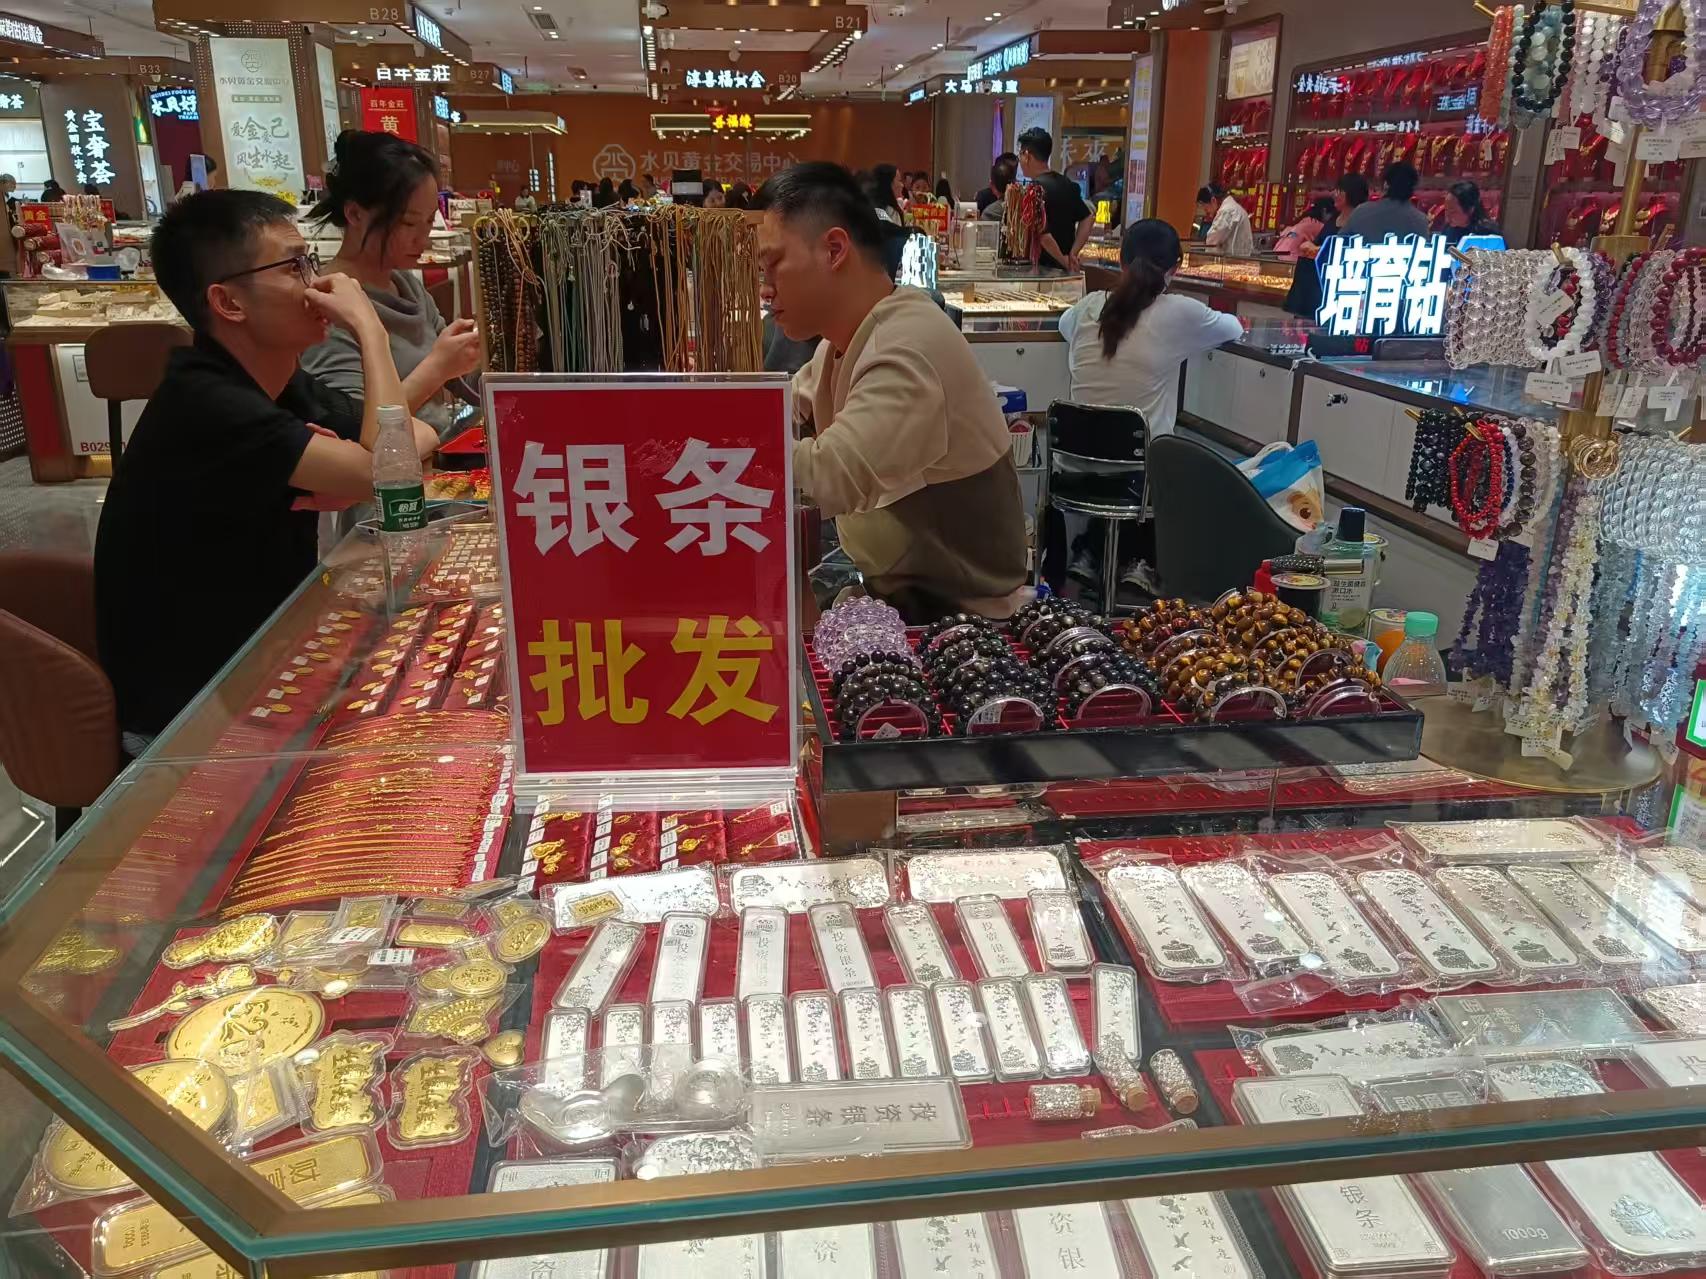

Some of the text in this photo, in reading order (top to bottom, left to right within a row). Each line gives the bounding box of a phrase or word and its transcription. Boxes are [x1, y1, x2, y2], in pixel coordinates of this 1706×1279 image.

[370, 8, 399, 20] B28
[835, 16, 861, 29] B21
[140, 65, 161, 74] B33
[1319, 234, 1452, 336] 培育钻
[512, 437, 775, 557] 银条
[527, 615, 780, 726] 批发
[1339, 1184, 1382, 1230] 银条
[1502, 1226, 1549, 1241] 1000g
